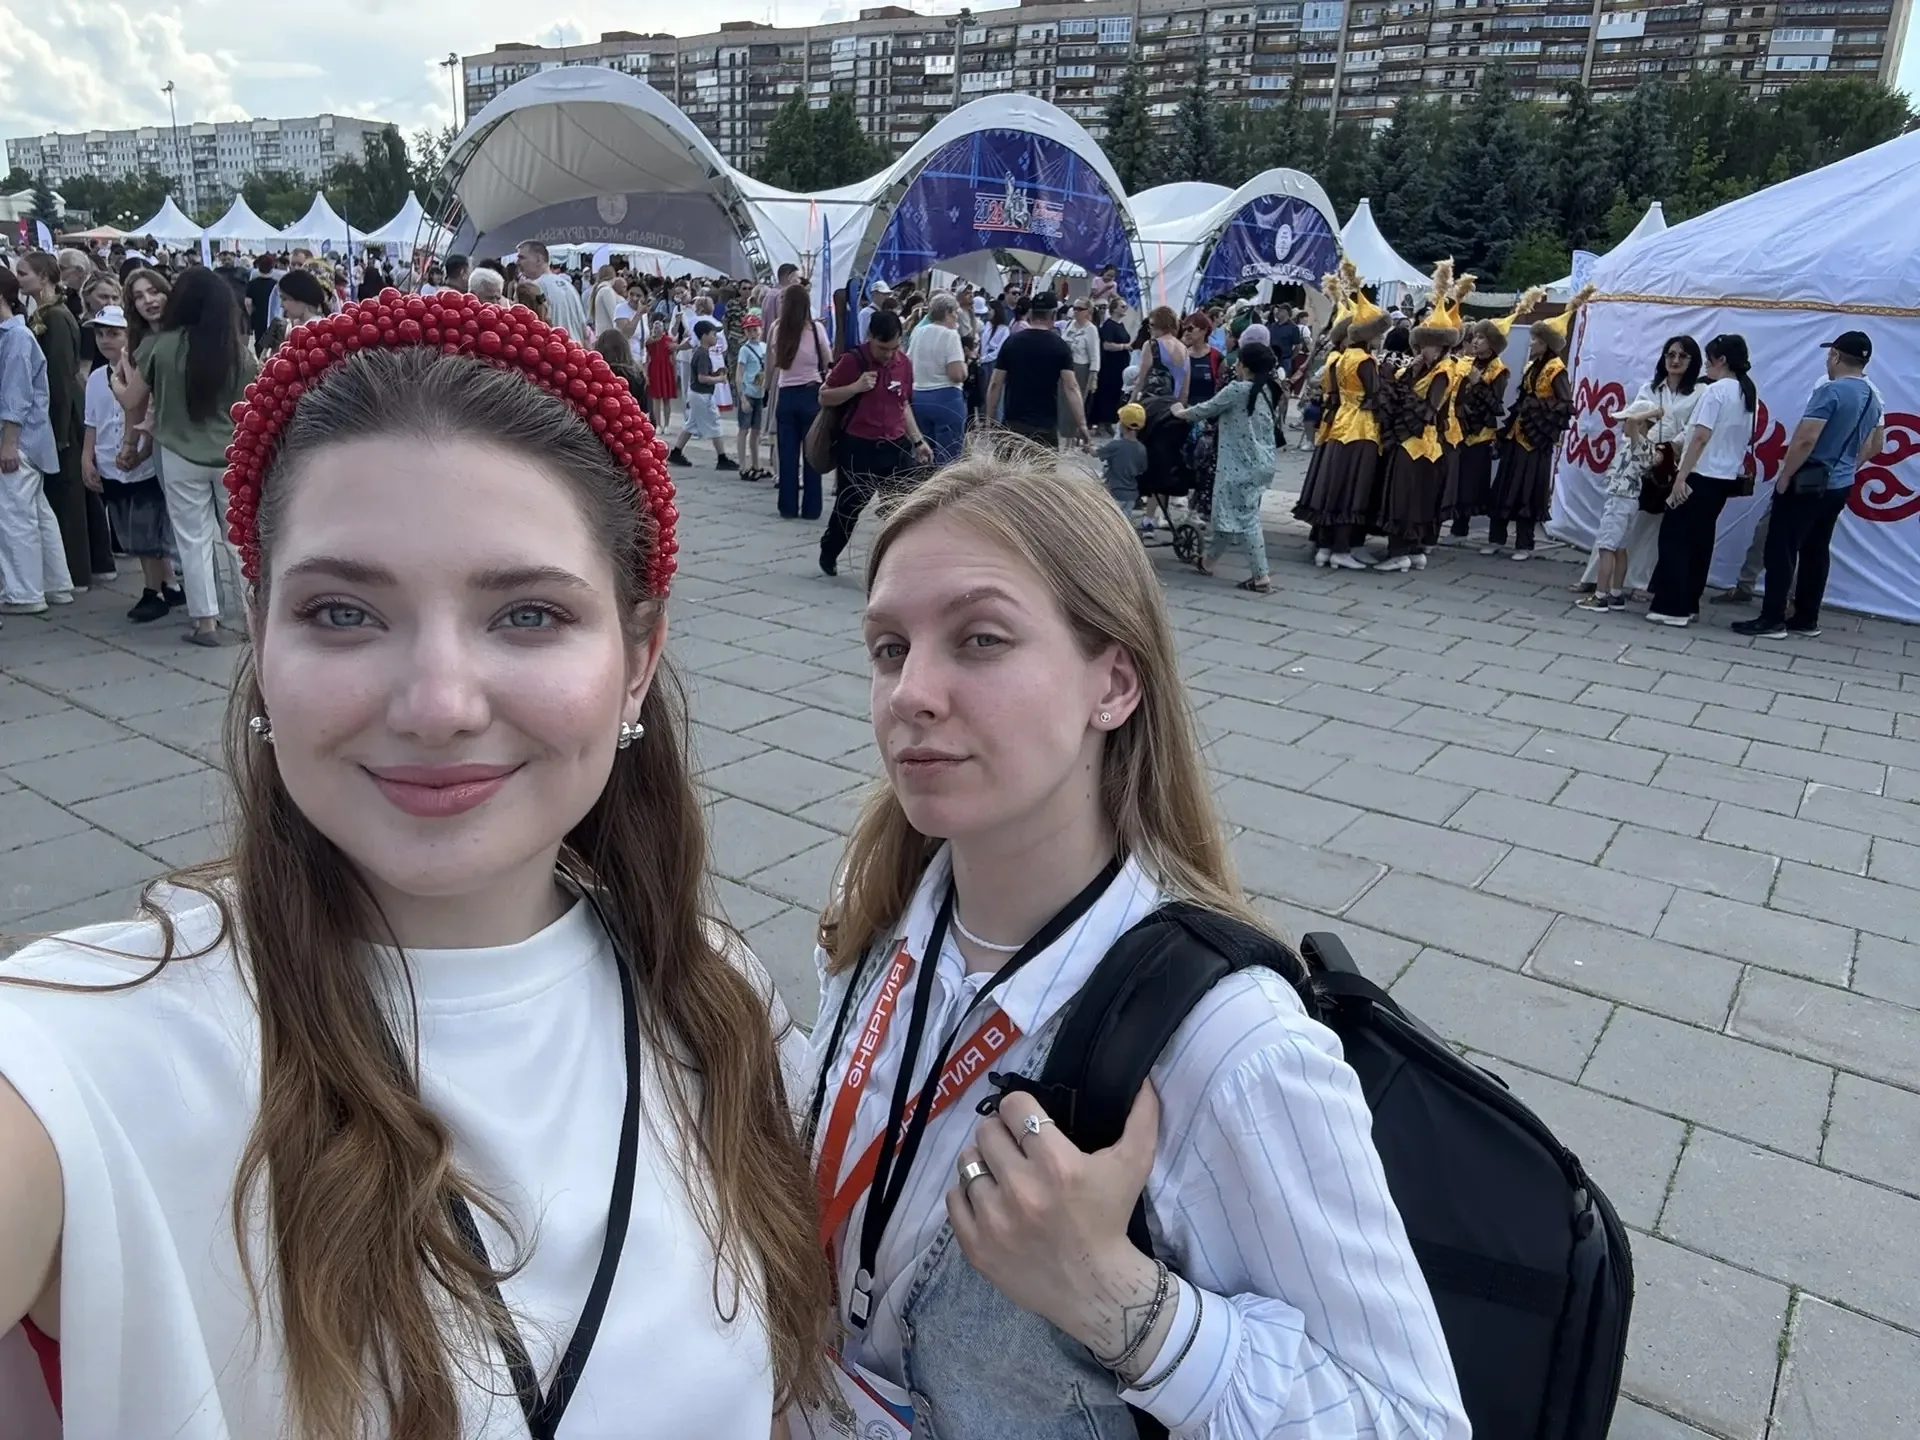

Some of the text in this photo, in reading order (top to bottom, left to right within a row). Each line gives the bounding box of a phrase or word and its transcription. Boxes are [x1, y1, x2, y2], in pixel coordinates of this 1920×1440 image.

[974, 199, 1004, 224] 2026
[847, 962, 905, 1089] ЭНЕРГИЯ
[895, 1026, 1006, 1145] НРГИЯ В
